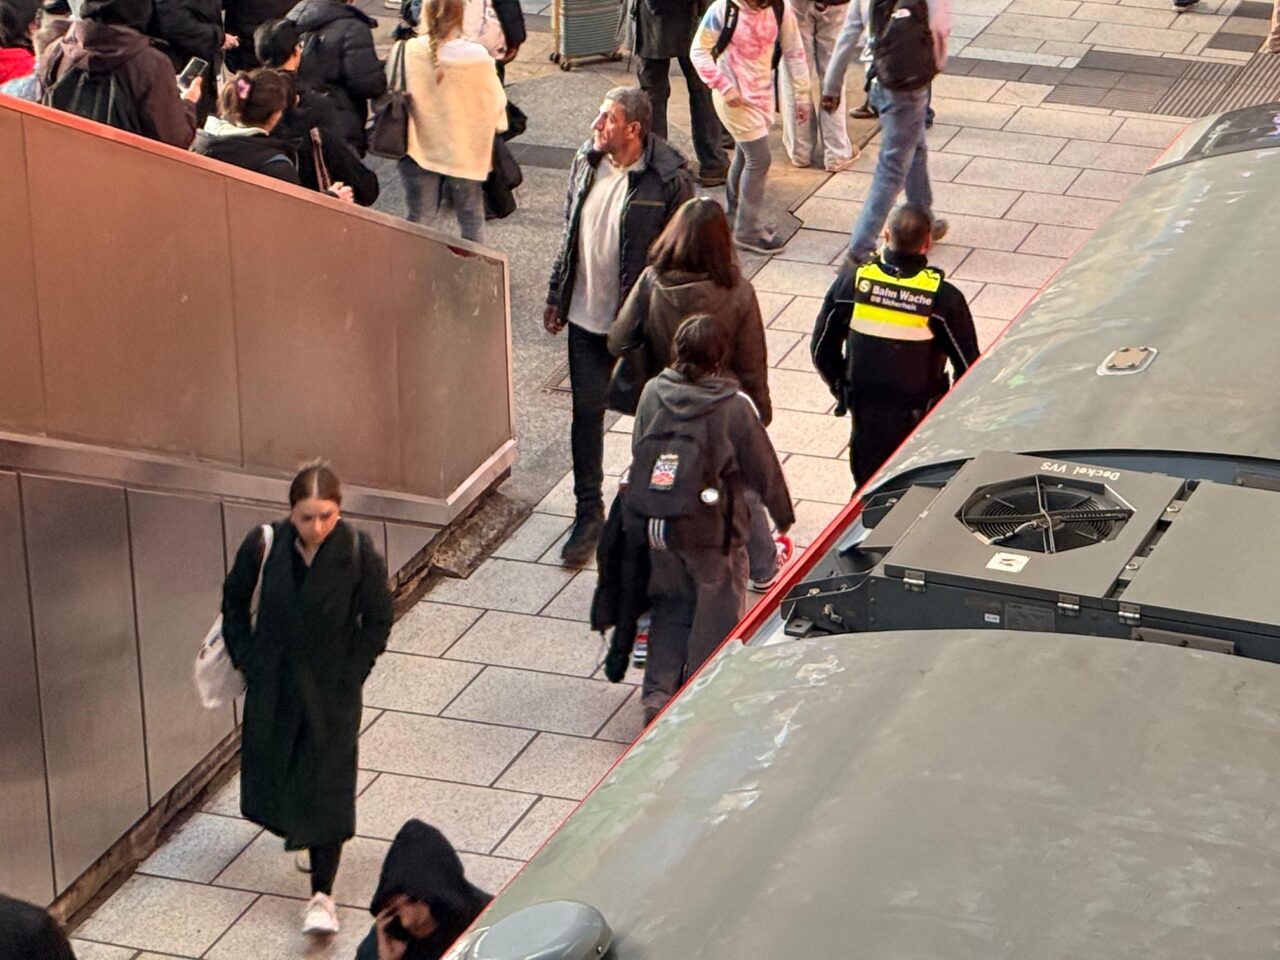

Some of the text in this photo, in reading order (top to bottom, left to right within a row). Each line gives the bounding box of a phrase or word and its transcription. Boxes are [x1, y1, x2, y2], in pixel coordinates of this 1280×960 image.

[872, 284, 898, 299] Bahn
[899, 290, 932, 306] Wache
[1040, 461, 1120, 481] Deckel VVS
